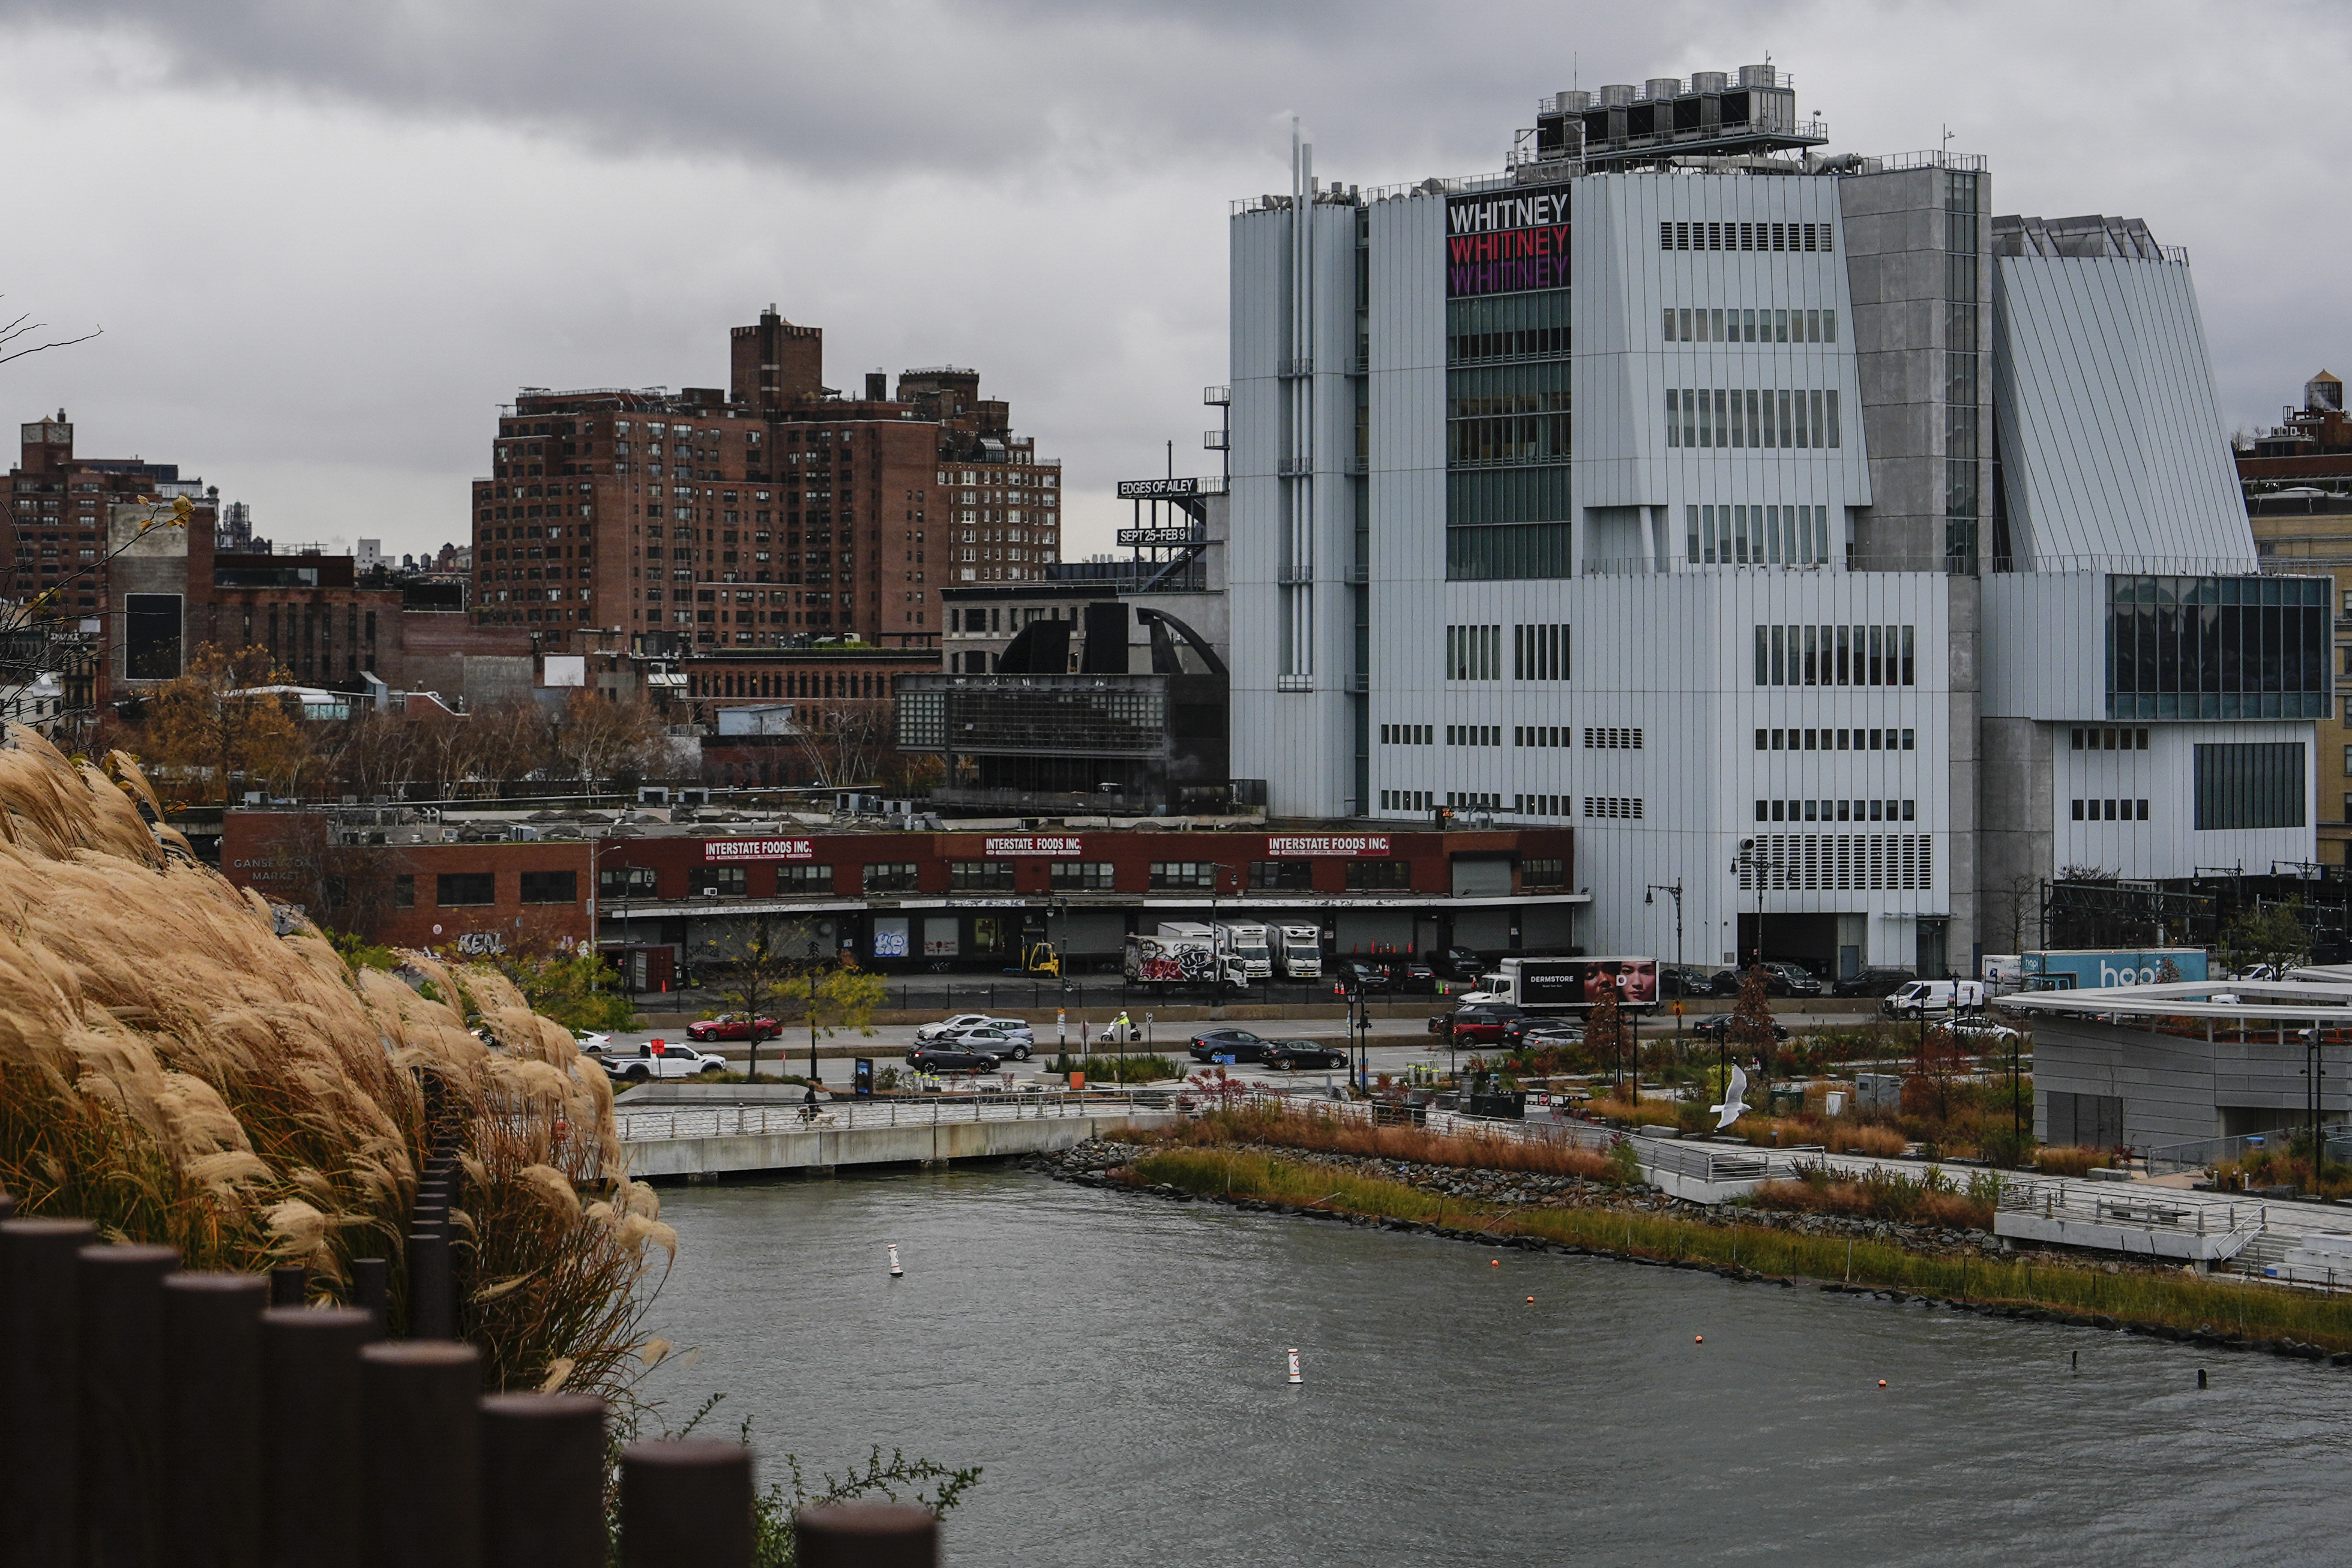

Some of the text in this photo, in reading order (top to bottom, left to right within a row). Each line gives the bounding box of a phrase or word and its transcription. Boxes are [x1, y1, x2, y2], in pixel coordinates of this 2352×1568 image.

[1450, 193, 1568, 233] WHITNEY
[1450, 225, 1569, 263] WHITNEY
[1451, 255, 1569, 296] WHITNEY
[1120, 479, 1194, 494] EDGES OF AILEY
[1120, 530, 1144, 542] SEPT
[1179, 529, 1186, 540] 9
[705, 840, 812, 855] INTERSTATE FOODS INC.
[985, 838, 1082, 850] INTERSTATE FOODS INC.
[1269, 838, 1389, 850] INTERSTATE FOODS INC.
[252, 871, 300, 880] MARKET
